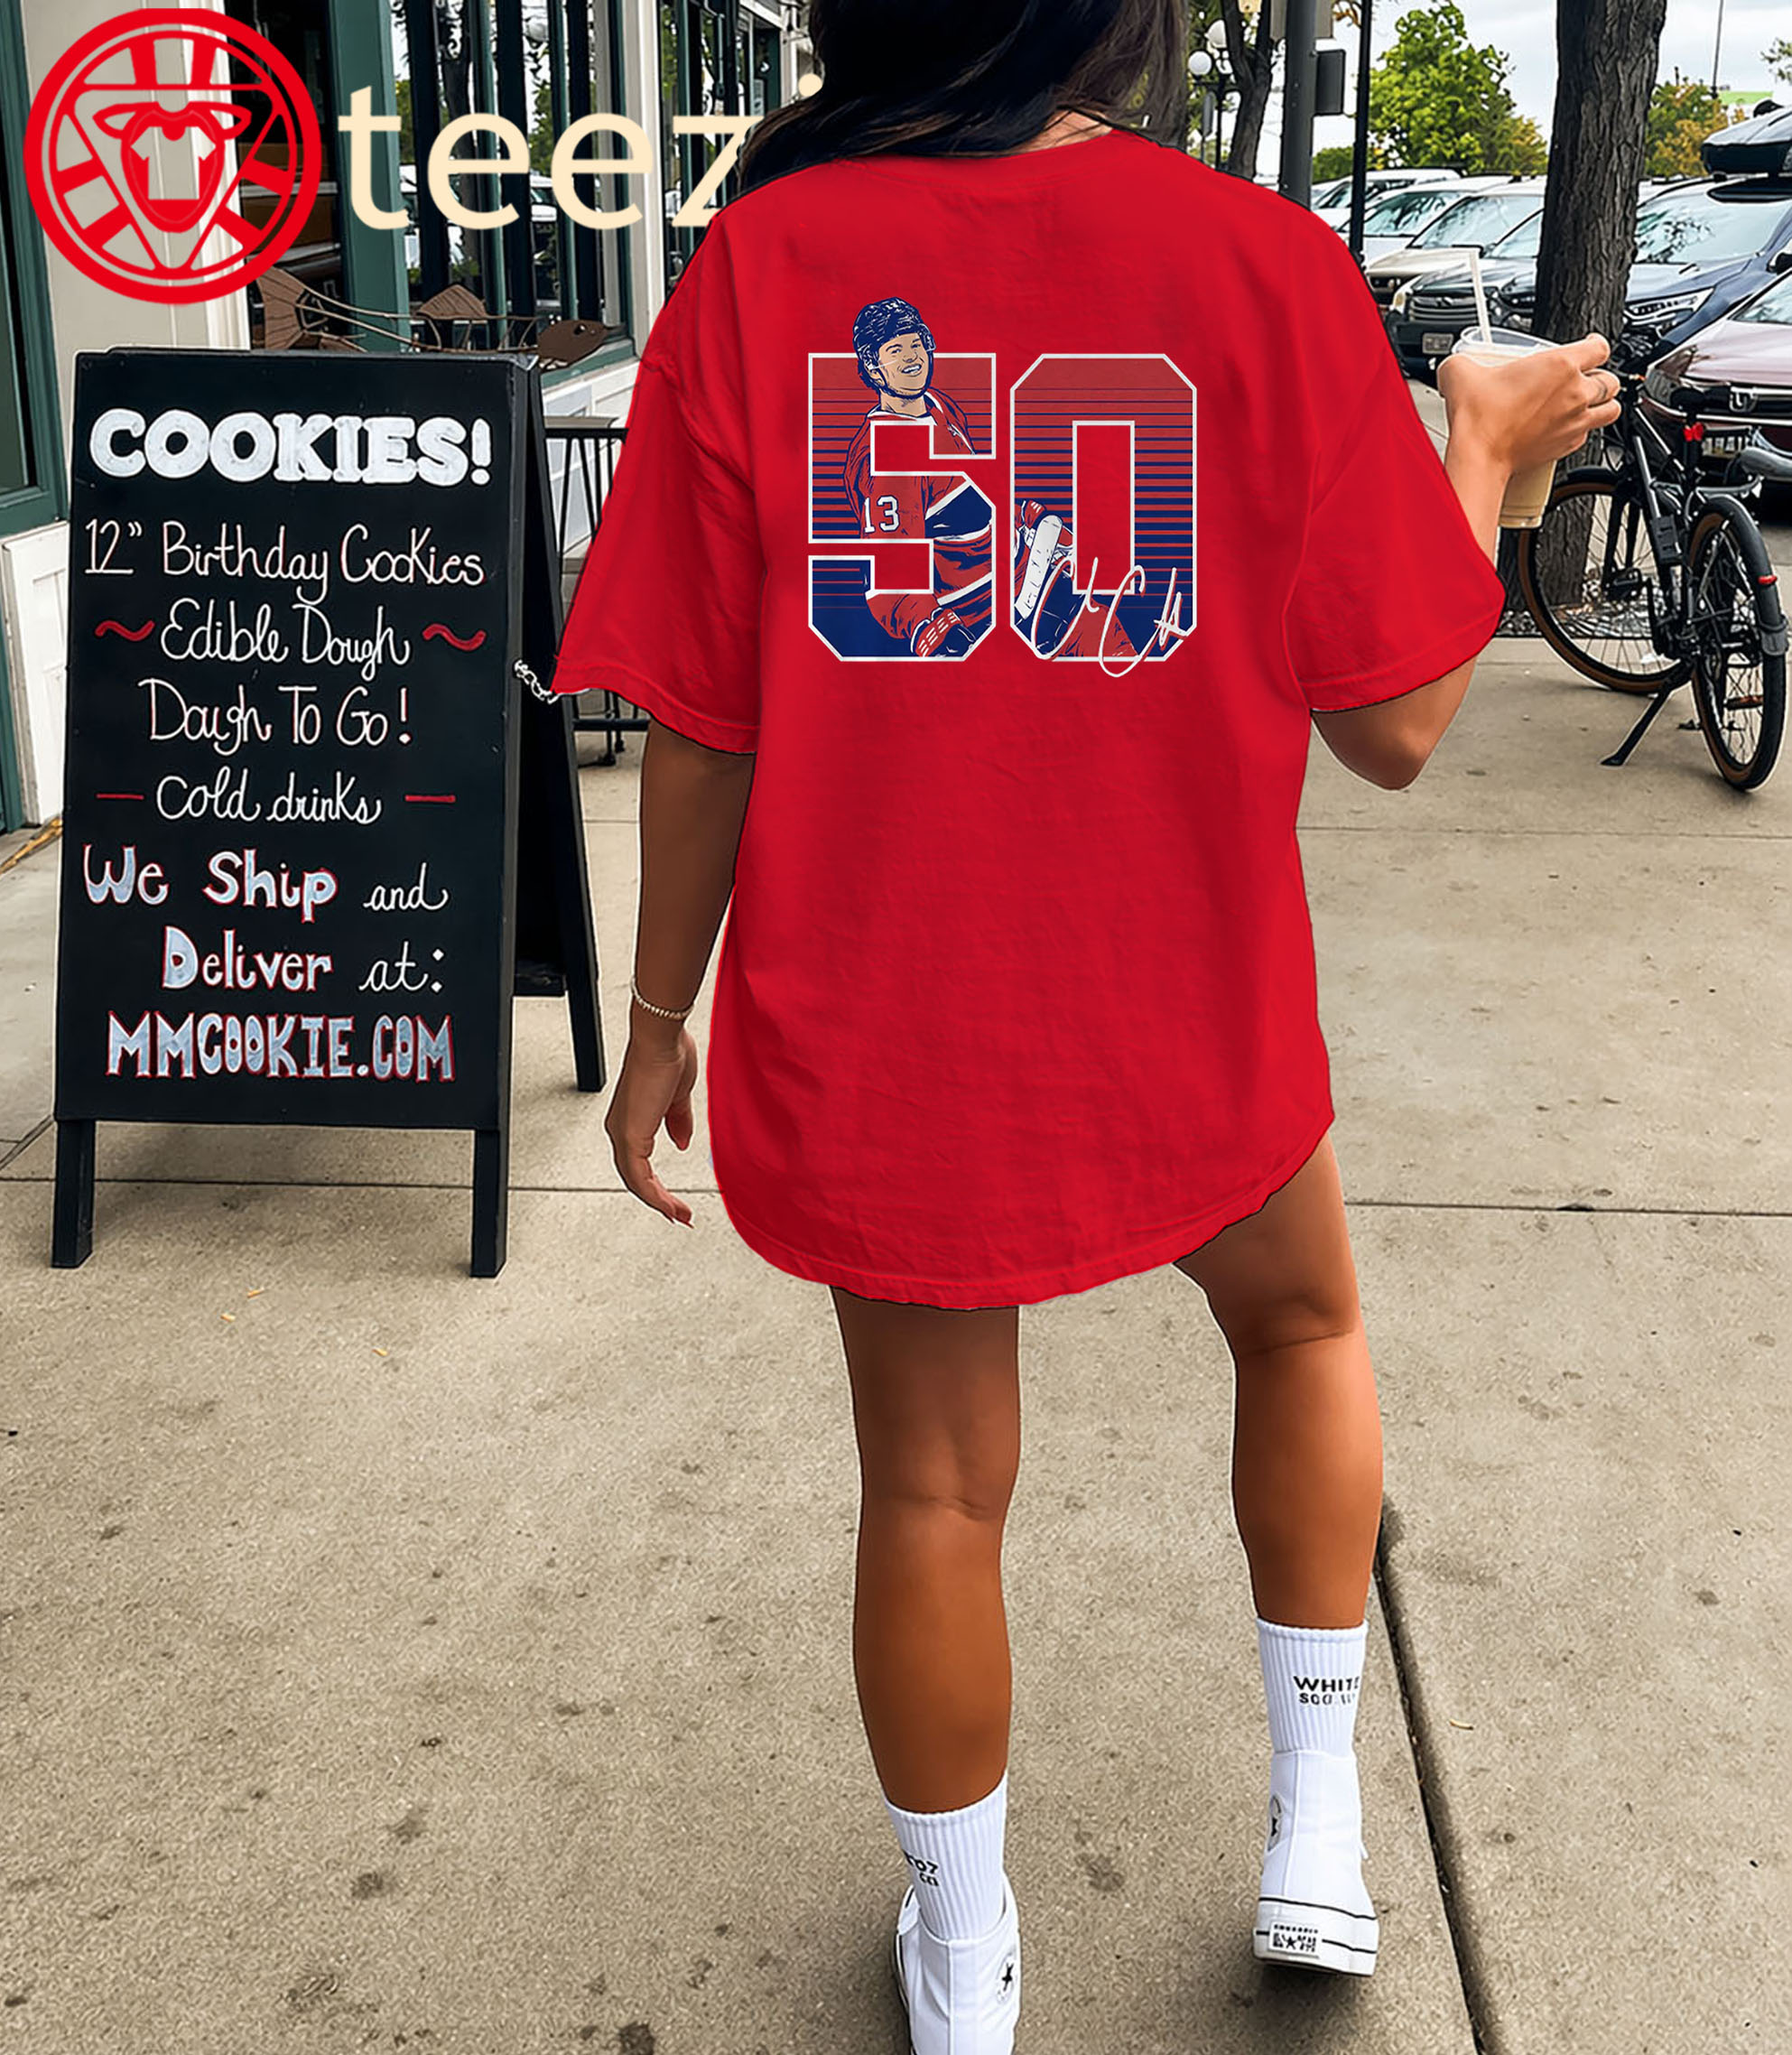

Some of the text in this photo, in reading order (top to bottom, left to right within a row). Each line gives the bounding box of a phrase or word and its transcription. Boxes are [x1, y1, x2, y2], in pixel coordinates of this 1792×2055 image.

[90, 409, 491, 486] COOKIES!
[808, 352, 1197, 662] 50
[864, 496, 899, 534] 13
[163, 521, 328, 604] Birthday
[161, 598, 410, 681] Edible Dough
[138, 678, 410, 756] Dough To Go!
[157, 766, 261, 821] Cold
[84, 845, 448, 923] We Ship and
[162, 926, 443, 992] Deliver at:
[107, 1011, 453, 1082] MMCOOKIE.COM
